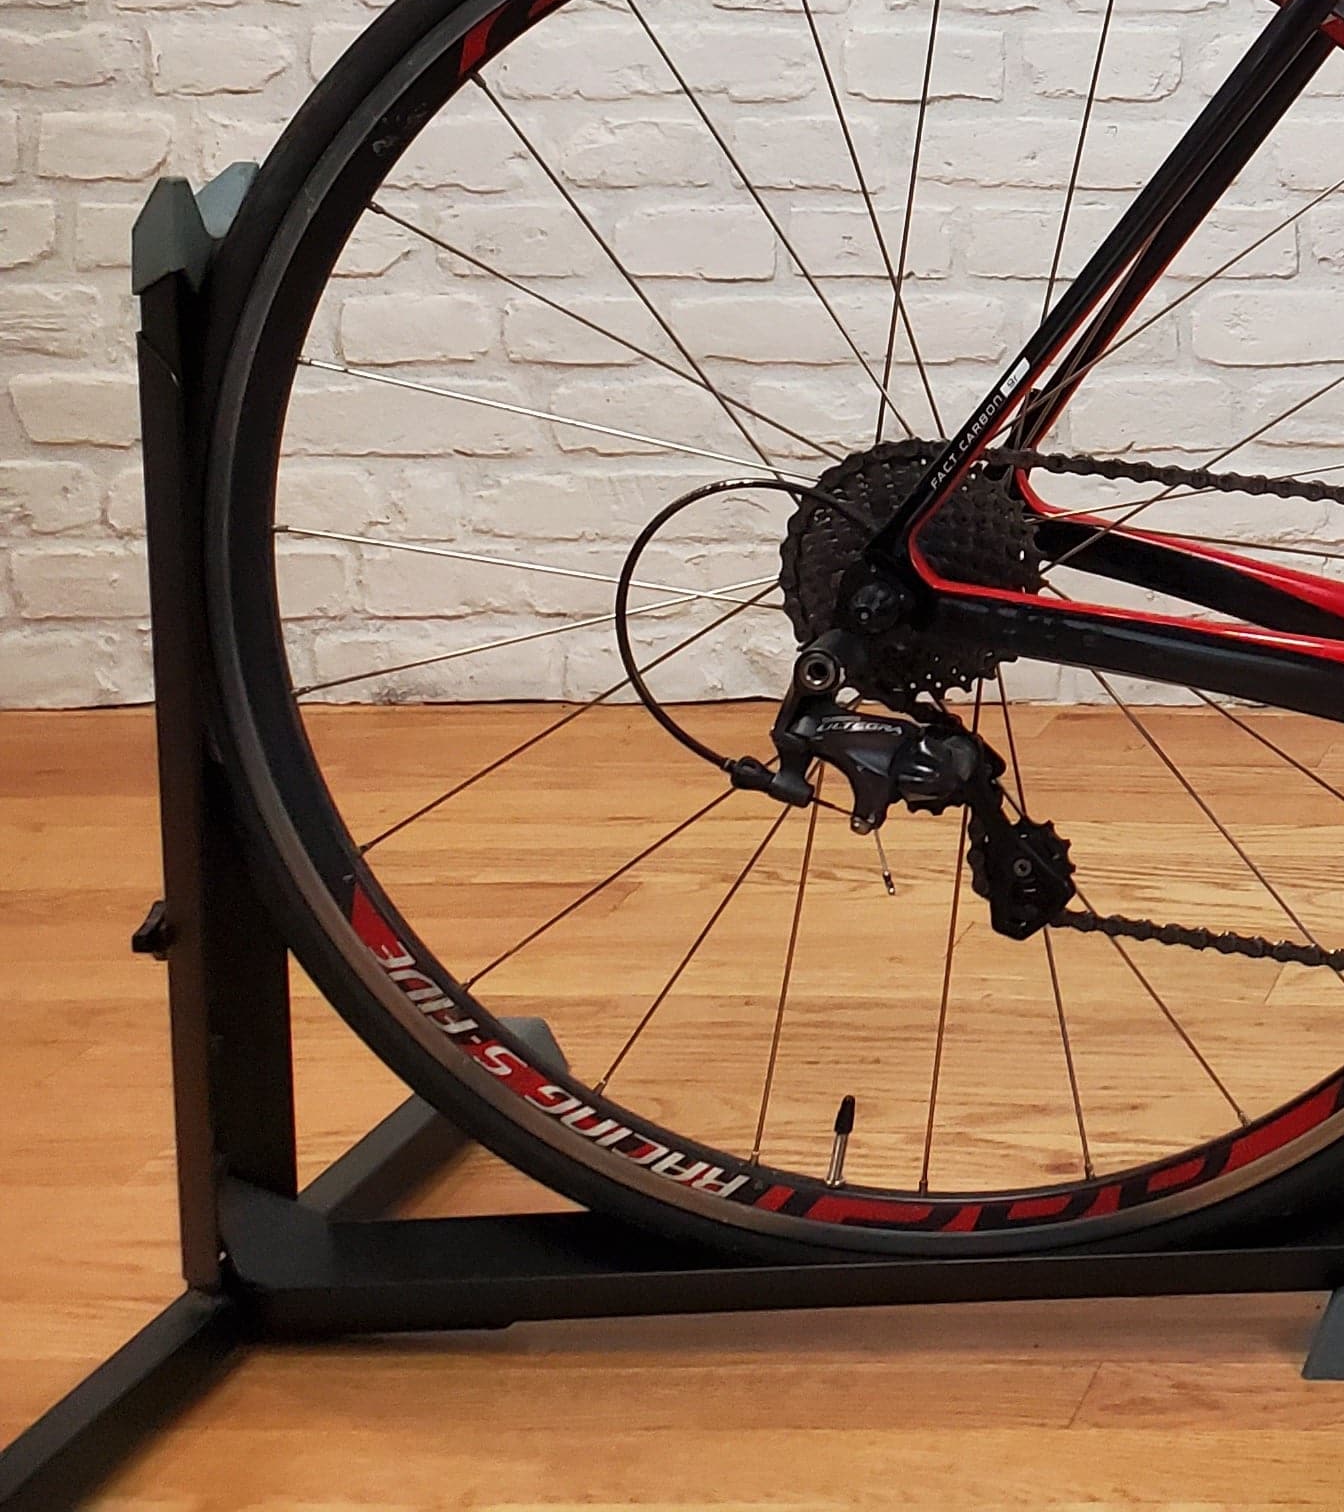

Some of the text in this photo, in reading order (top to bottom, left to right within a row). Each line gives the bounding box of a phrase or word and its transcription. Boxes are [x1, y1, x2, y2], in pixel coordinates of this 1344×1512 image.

[931, 455, 960, 490] FACT
[958, 393, 1006, 456] CARBON
[524, 1084, 752, 1200] RACING
